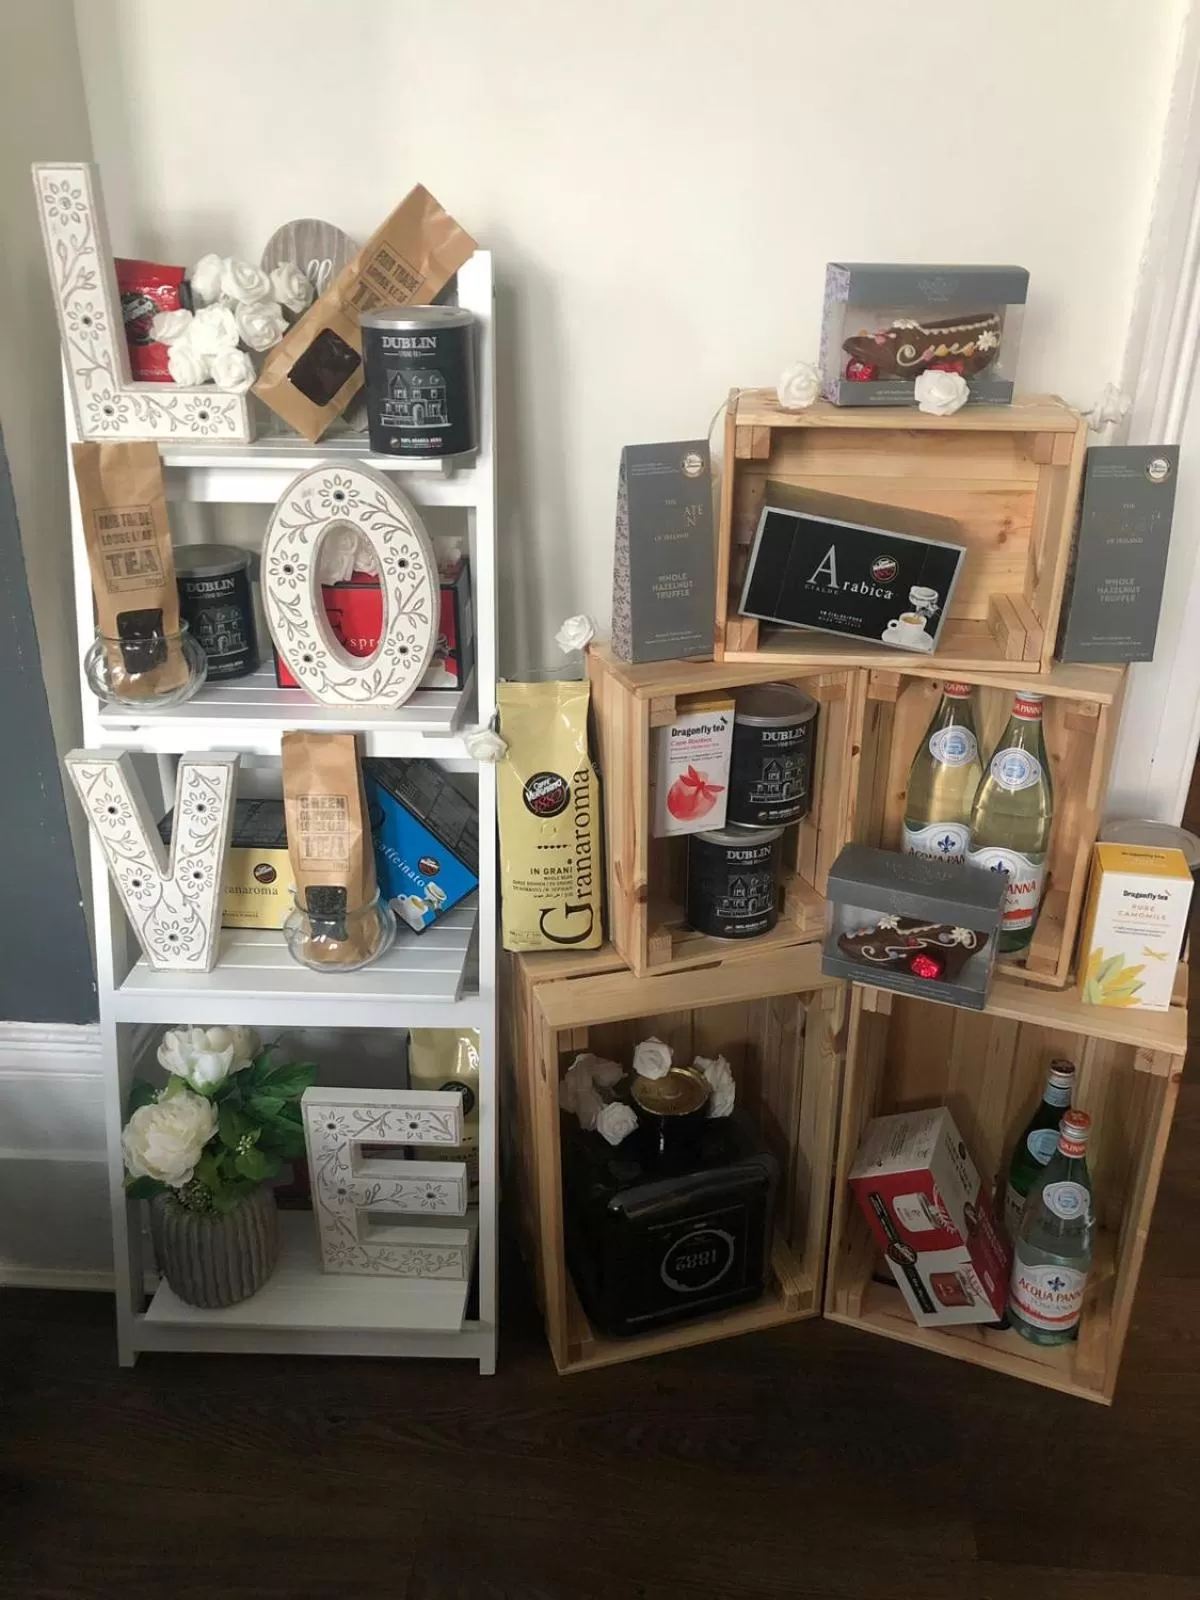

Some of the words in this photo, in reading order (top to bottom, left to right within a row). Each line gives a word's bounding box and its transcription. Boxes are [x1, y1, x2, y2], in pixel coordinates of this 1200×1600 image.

[382, 336, 437, 349] DUBLIN
[105, 549, 159, 577] TEA
[658, 572, 688, 583] WHOLE
[806, 543, 893, 600] Arabica
[186, 578, 235, 593] DUBLIN
[655, 589, 690, 601] TRUFFLE
[672, 725, 712, 737] Dragonfly
[762, 726, 807, 741] DUBLIN
[540, 768, 594, 945] Granaroma
[727, 845, 773, 860] DUBLIN
[530, 867, 541, 876] IN
[543, 866, 574, 876] GRANI
[1005, 879, 1037, 895] ANNA
[1123, 889, 1157, 901] Dragonfly
[1131, 903, 1156, 912] PURE
[1019, 1277, 1054, 1303] ACQUA
